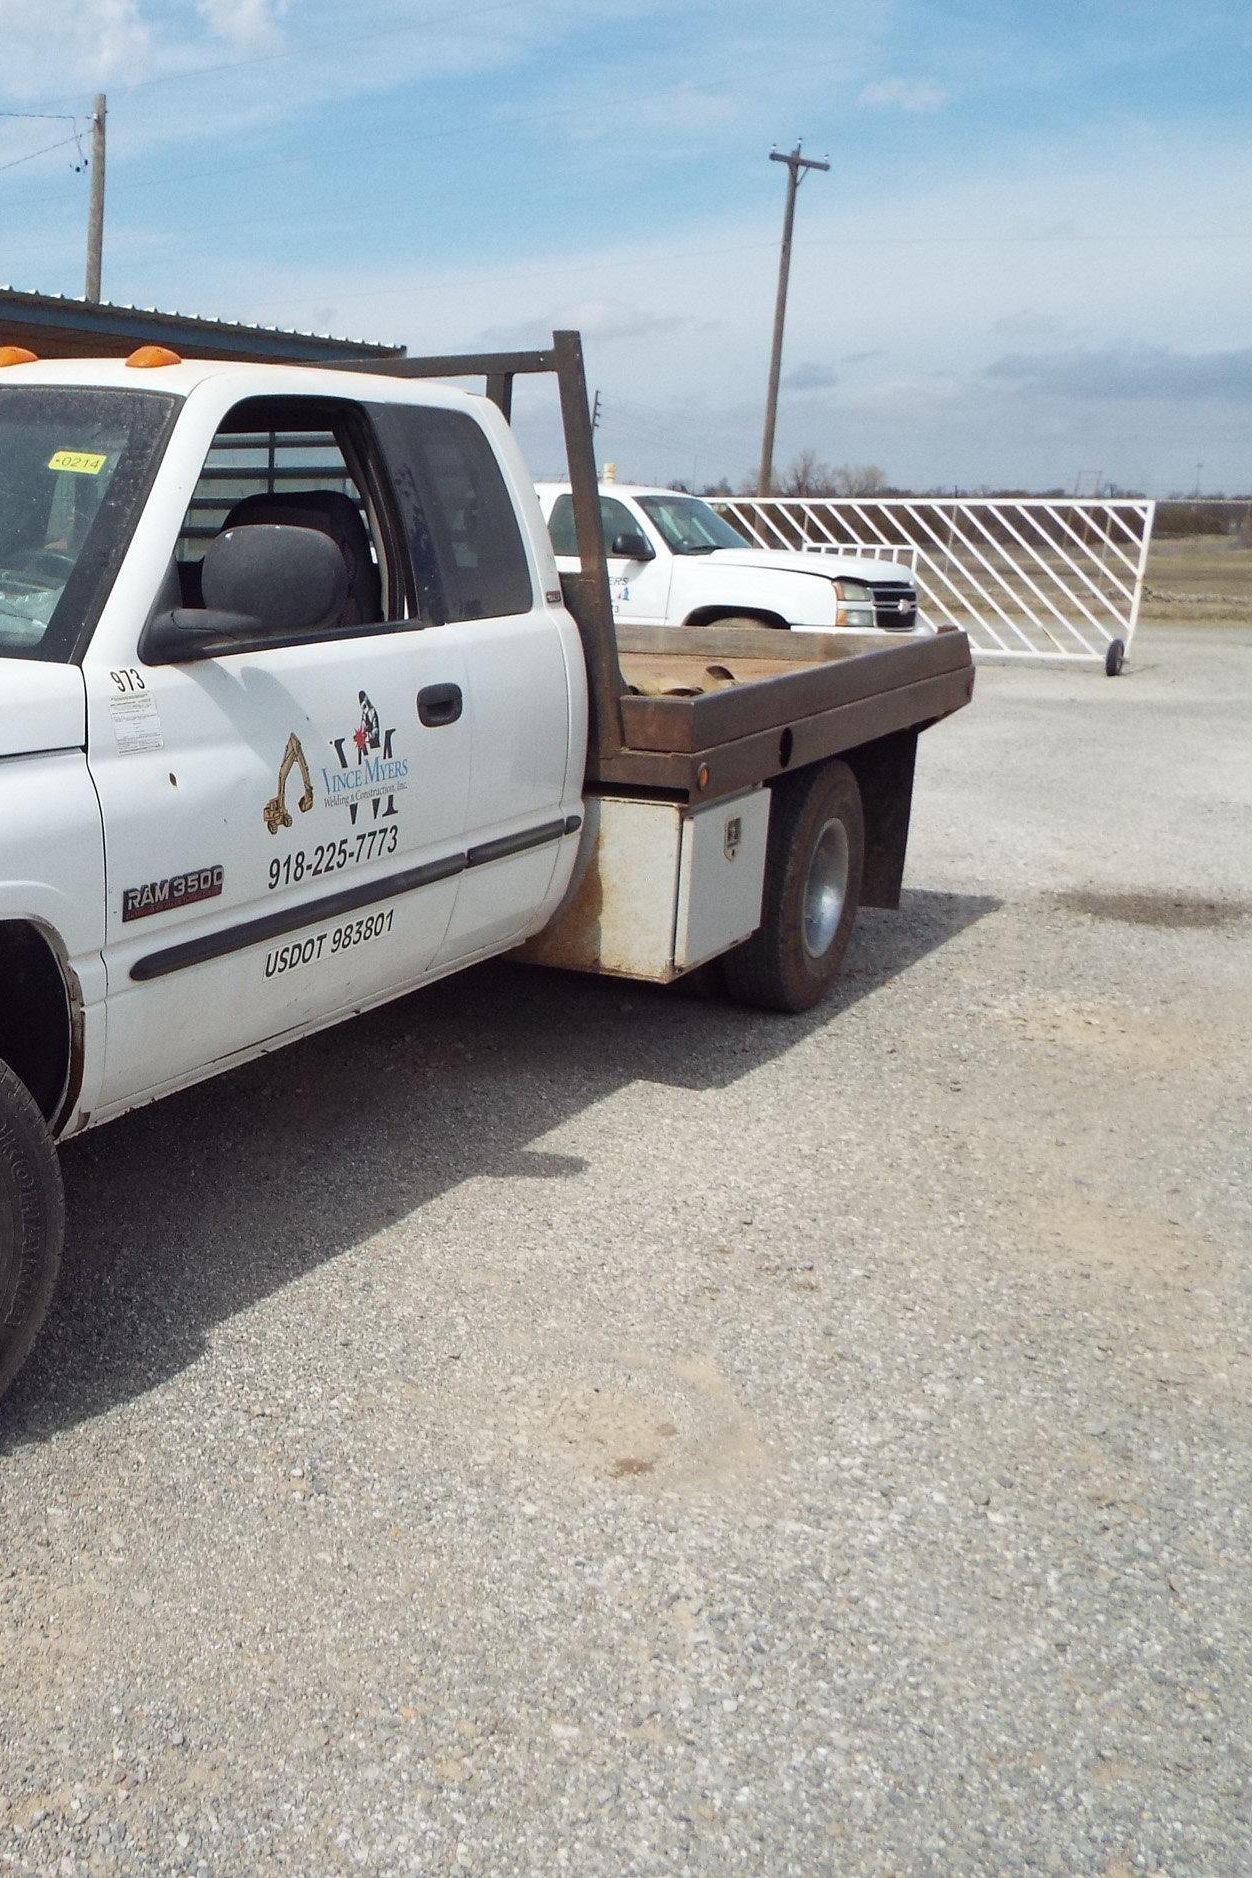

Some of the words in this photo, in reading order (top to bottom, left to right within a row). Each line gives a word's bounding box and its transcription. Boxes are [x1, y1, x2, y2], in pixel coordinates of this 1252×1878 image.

[109, 668, 146, 692] 973
[321, 767, 363, 795] VINCE
[363, 756, 408, 785] MYERS
[268, 824, 398, 890] 918-225-7773
[127, 882, 169, 910] RAM
[173, 865, 224, 897] 3500
[265, 933, 328, 977] USDOT
[330, 909, 394, 953] 983801
